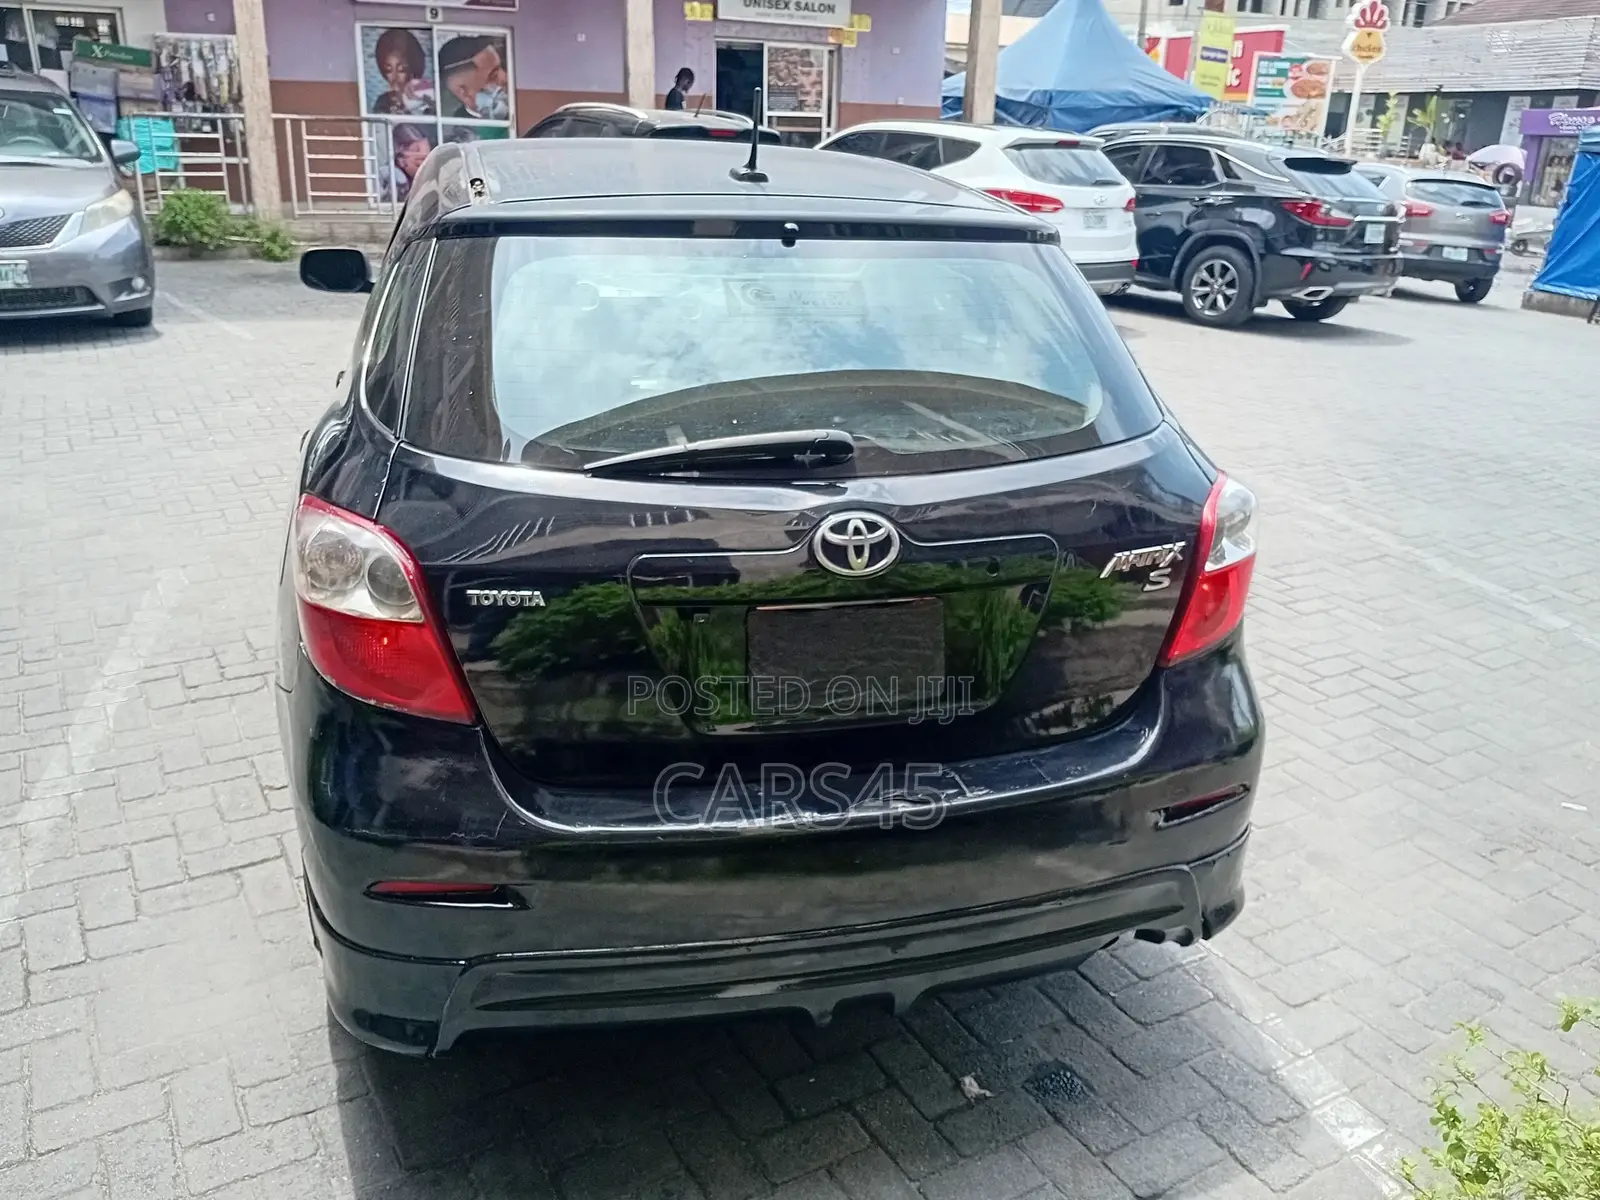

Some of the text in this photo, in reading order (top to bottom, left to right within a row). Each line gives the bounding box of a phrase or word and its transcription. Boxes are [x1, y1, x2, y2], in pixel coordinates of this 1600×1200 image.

[429, 8, 439, 19] 9
[743, 0, 836, 14] UNISEX SALON
[1142, 567, 1172, 592] S
[466, 589, 546, 607] TOYOTA
